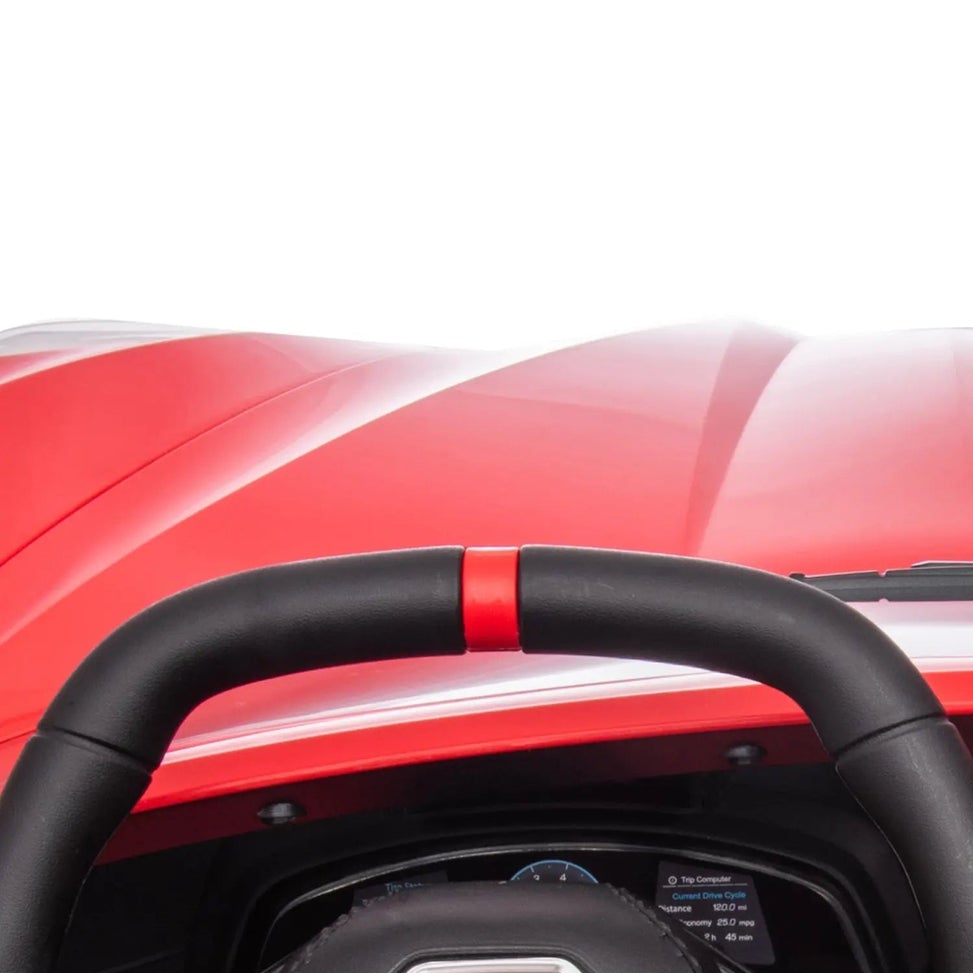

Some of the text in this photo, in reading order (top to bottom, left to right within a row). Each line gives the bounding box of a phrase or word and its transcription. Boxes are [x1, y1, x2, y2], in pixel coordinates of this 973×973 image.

[681, 875, 731, 884] Trip Computer
[672, 891, 747, 901] Current Drive Cycle
[658, 904, 692, 913] istance
[713, 903, 736, 911] 120.0
[716, 918, 736, 927] 25.0
[724, 933, 737, 942] 45
